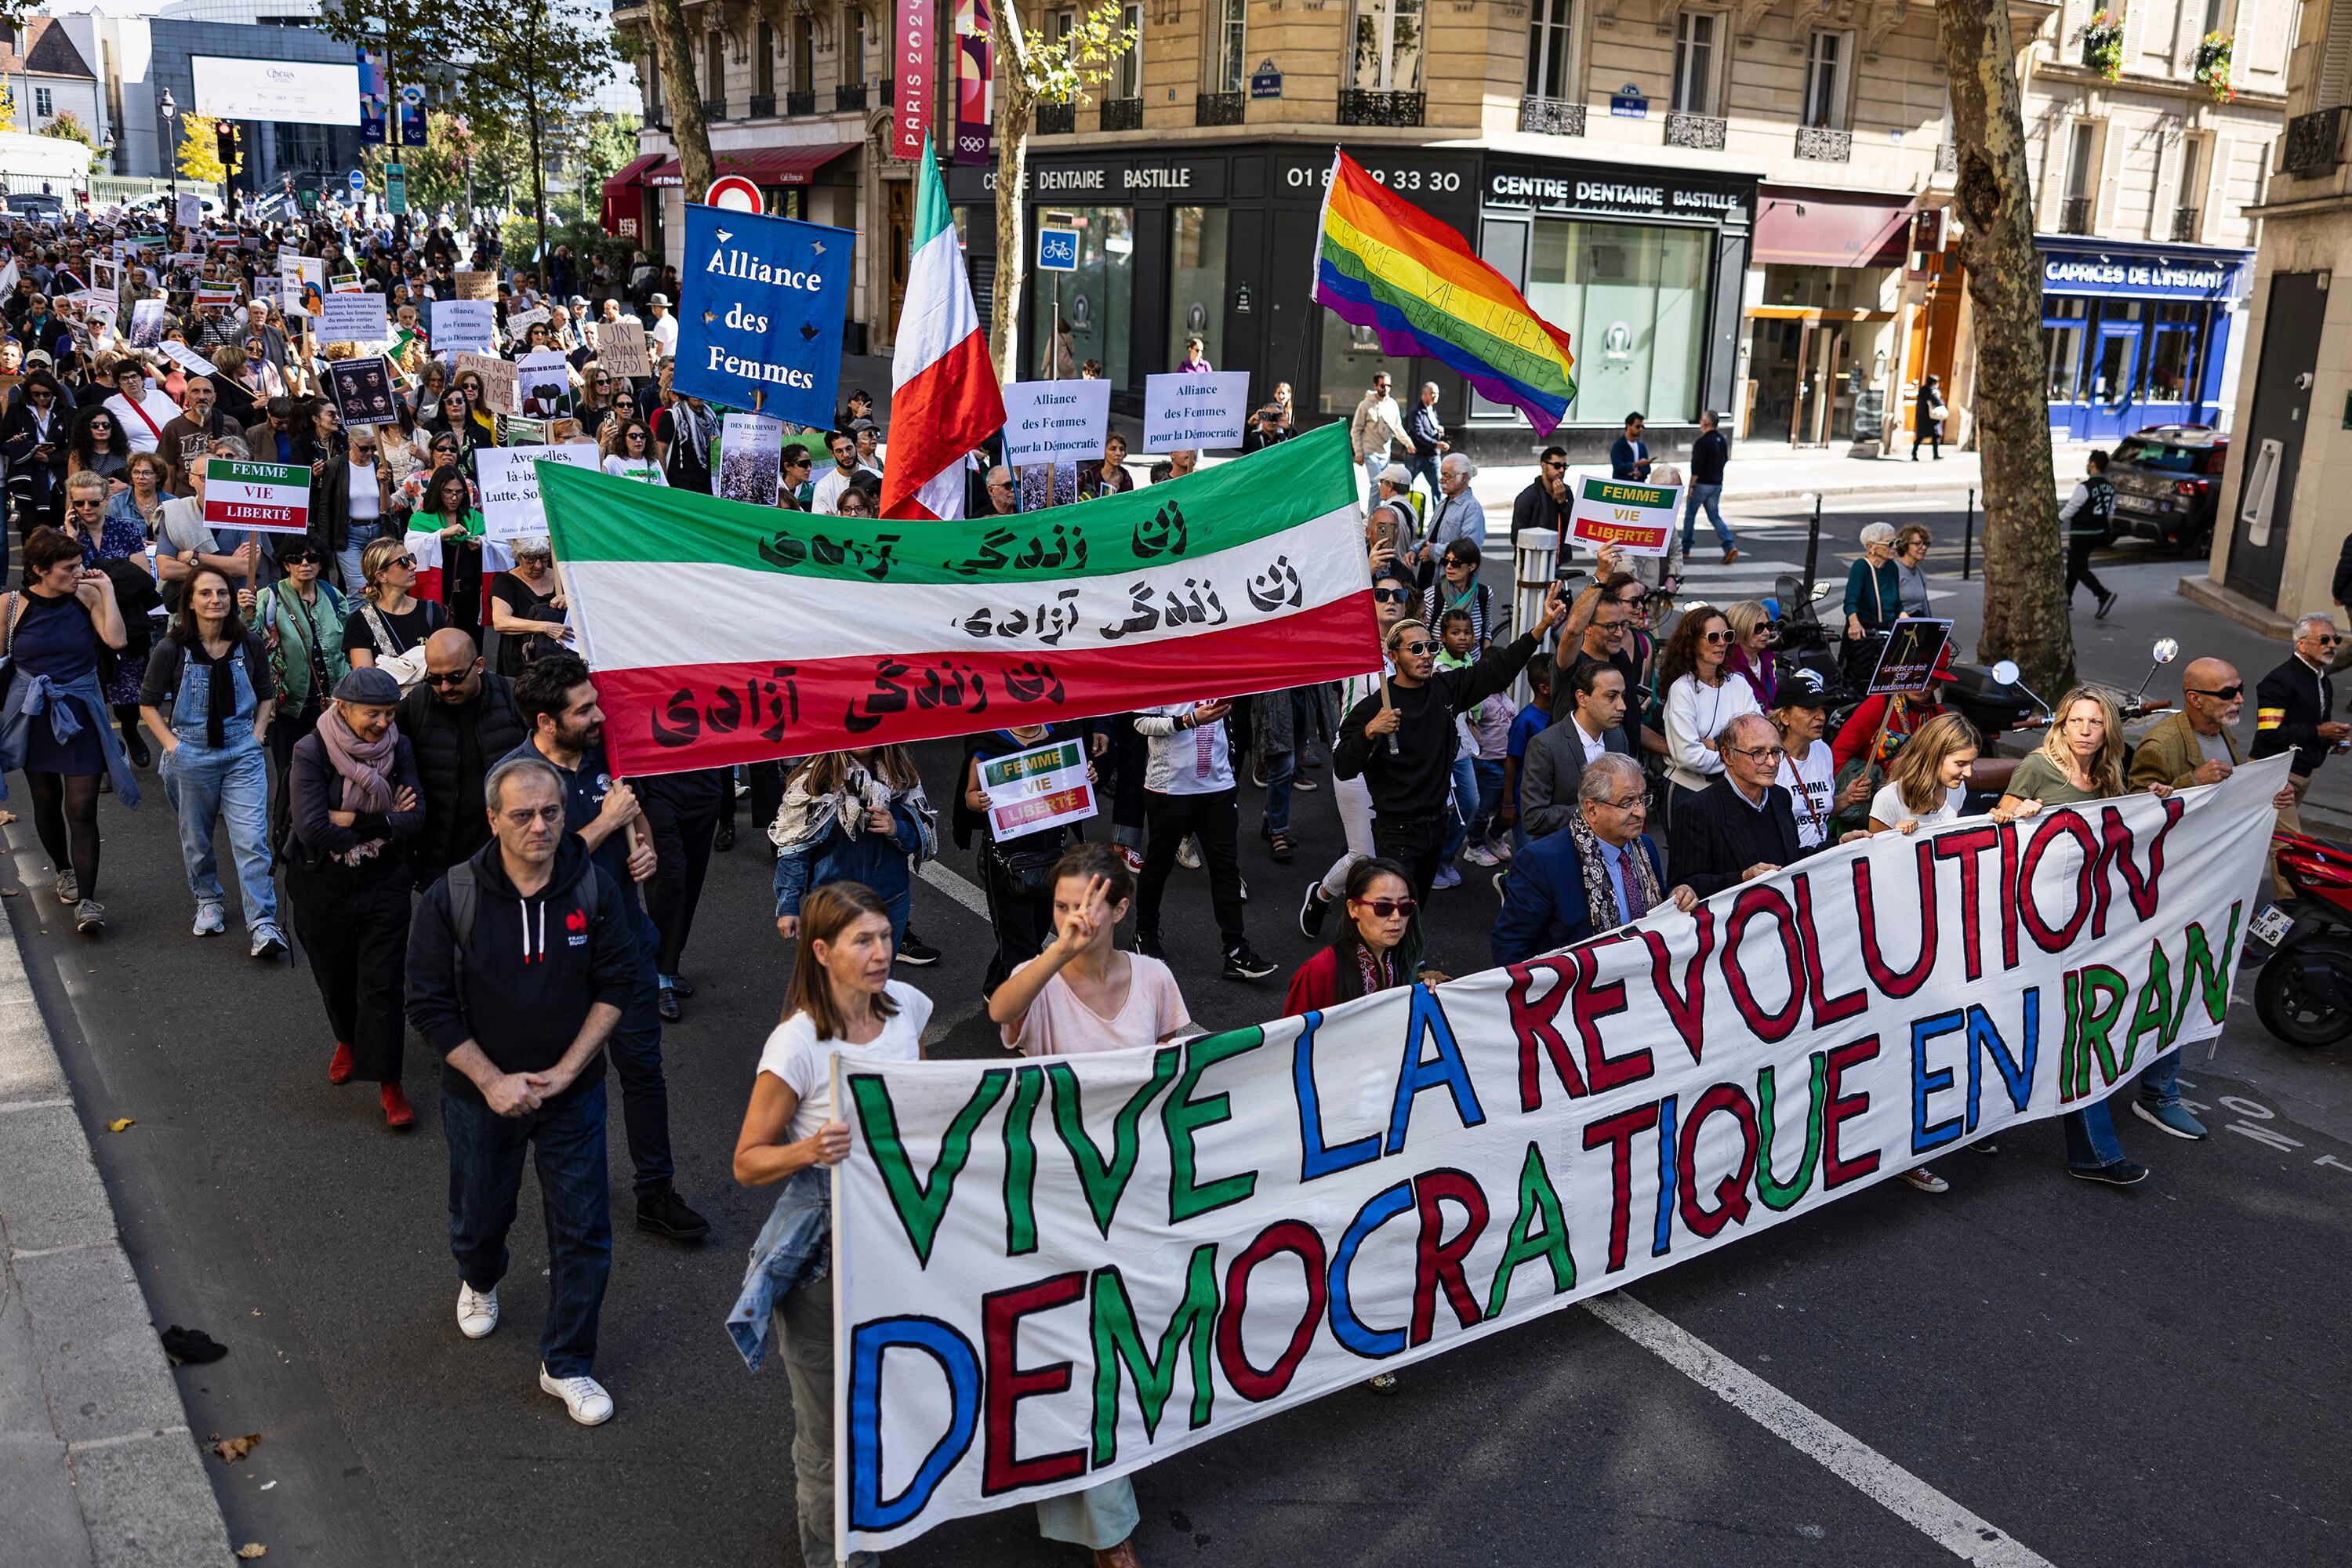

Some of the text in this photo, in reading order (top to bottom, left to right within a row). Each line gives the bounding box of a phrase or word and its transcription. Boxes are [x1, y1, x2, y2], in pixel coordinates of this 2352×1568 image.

[983, 169, 1190, 190] CEE DENTAIRE BASTILLE
[1287, 168, 1313, 187] 01
[1393, 172, 1421, 189] 33
[1429, 172, 1460, 191] 30
[1494, 176, 1737, 210] CENTRE DENTAIRE BASTILLE
[706, 249, 822, 292] Alliance
[1330, 212, 1399, 279] FEMME
[1426, 271, 1465, 316] VIE
[2045, 262, 2224, 289] CAPRICES DE L'INSTANT
[725, 303, 768, 333] des
[1404, 296, 1466, 344] TRANS
[604, 325, 632, 344] JIN
[605, 345, 638, 362] JIYAN
[459, 354, 474, 366] ON
[476, 358, 490, 371] NE
[608, 359, 643, 375] AZADI
[707, 346, 814, 389] Femmes
[1176, 385, 1218, 396] Alliance
[1033, 394, 1077, 405] Alliance
[1164, 407, 1226, 419] des Femmes
[1022, 416, 1087, 430] des Femmes
[1150, 428, 1239, 445] pour la Démocratie
[1008, 438, 1099, 456] pour la Démocratie
[543, 450, 572, 462] elles,
[231, 463, 288, 478] FEMME
[507, 470, 538, 482] là-ba
[245, 486, 273, 499] VIE
[485, 492, 520, 503] Lutte,
[1602, 485, 1661, 503] FEMME
[227, 506, 291, 521] LIBERTÉ
[1614, 508, 1641, 521] VIE
[1587, 524, 1655, 543] LIBERTÉ
[1004, 752, 1061, 777] FEMME
[1023, 777, 1052, 794] VIE
[1791, 781, 1829, 796] FEMME
[1008, 790, 1078, 822] LIBERTÉ
[2267, 912, 2280, 923] GP
[850, 793, 2184, 1270] VIVE LA REVOLUTION
[846, 898, 2241, 1534] DEMOCRATIQUE EN IRAN
